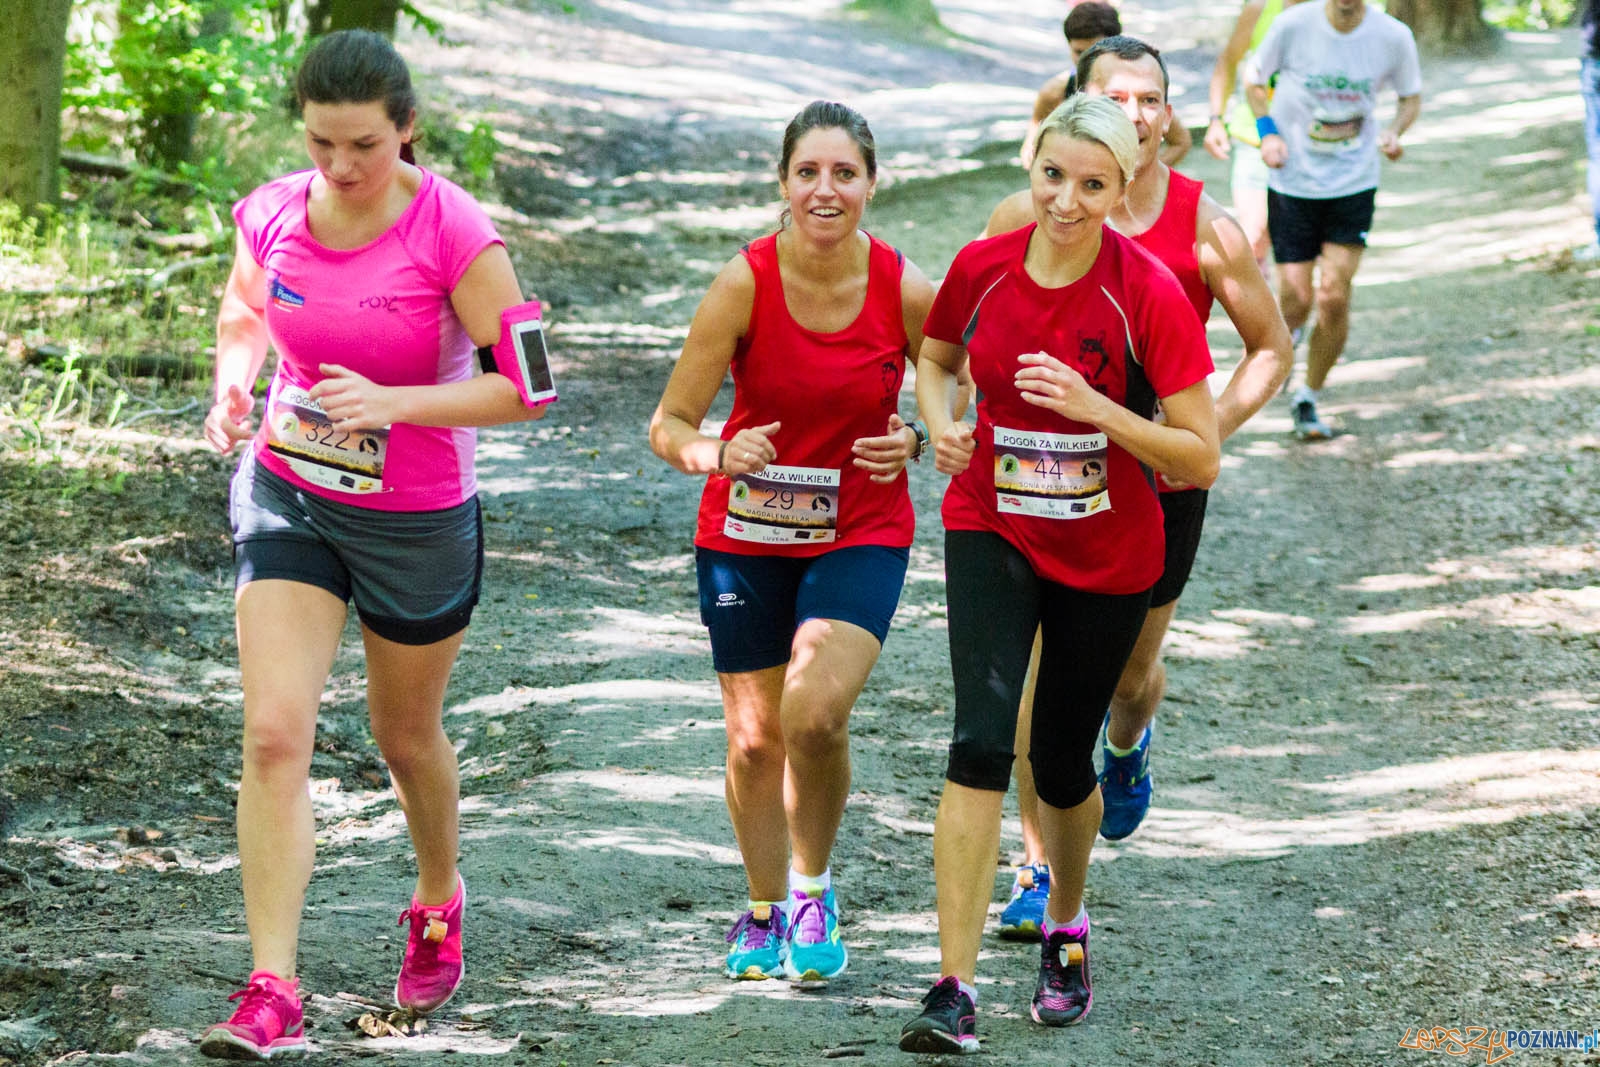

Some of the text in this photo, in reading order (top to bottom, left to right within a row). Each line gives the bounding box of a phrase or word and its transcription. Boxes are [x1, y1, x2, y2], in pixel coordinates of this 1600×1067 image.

[305, 418, 349, 451] 322
[1003, 435, 1099, 450] POGOŃ ZA WILKIEM
[772, 471, 786, 481] ZA
[788, 473, 832, 484] WILKIEM
[1034, 457, 1064, 480] 44
[763, 487, 795, 510] 29
[746, 508, 790, 520] MAGDALENA
